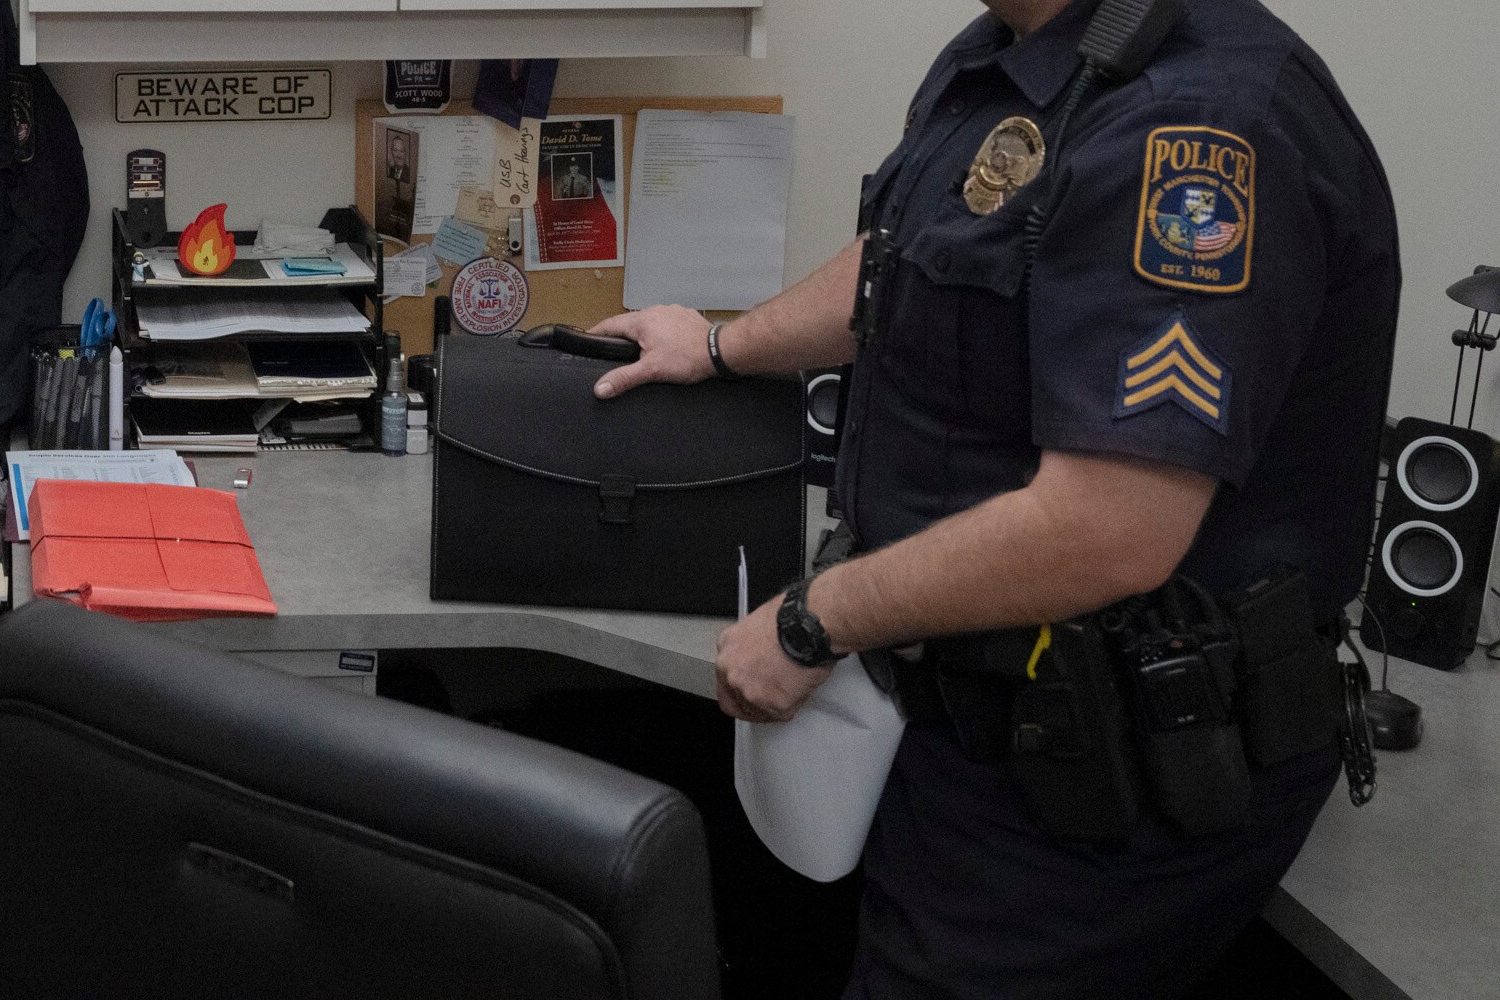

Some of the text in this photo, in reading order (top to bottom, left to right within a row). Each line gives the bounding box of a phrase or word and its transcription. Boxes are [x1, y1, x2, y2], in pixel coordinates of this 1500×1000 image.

[401, 61, 437, 76] POLICE
[137, 76, 310, 96] BEWARE OF
[414, 75, 424, 83] PA
[395, 89, 443, 98] SCOTT WOOD
[133, 96, 315, 117] ATTACK COP
[541, 133, 603, 144] David D. Tome
[500, 158, 511, 188] USB
[1151, 138, 1250, 198] POLICE
[1160, 263, 1221, 281] EST. 1960
[454, 271, 525, 332] FIRE AND EXPLOSION INVESTIGATOR
[477, 298, 501, 309] NAFI
[811, 452, 836, 463] logitech
